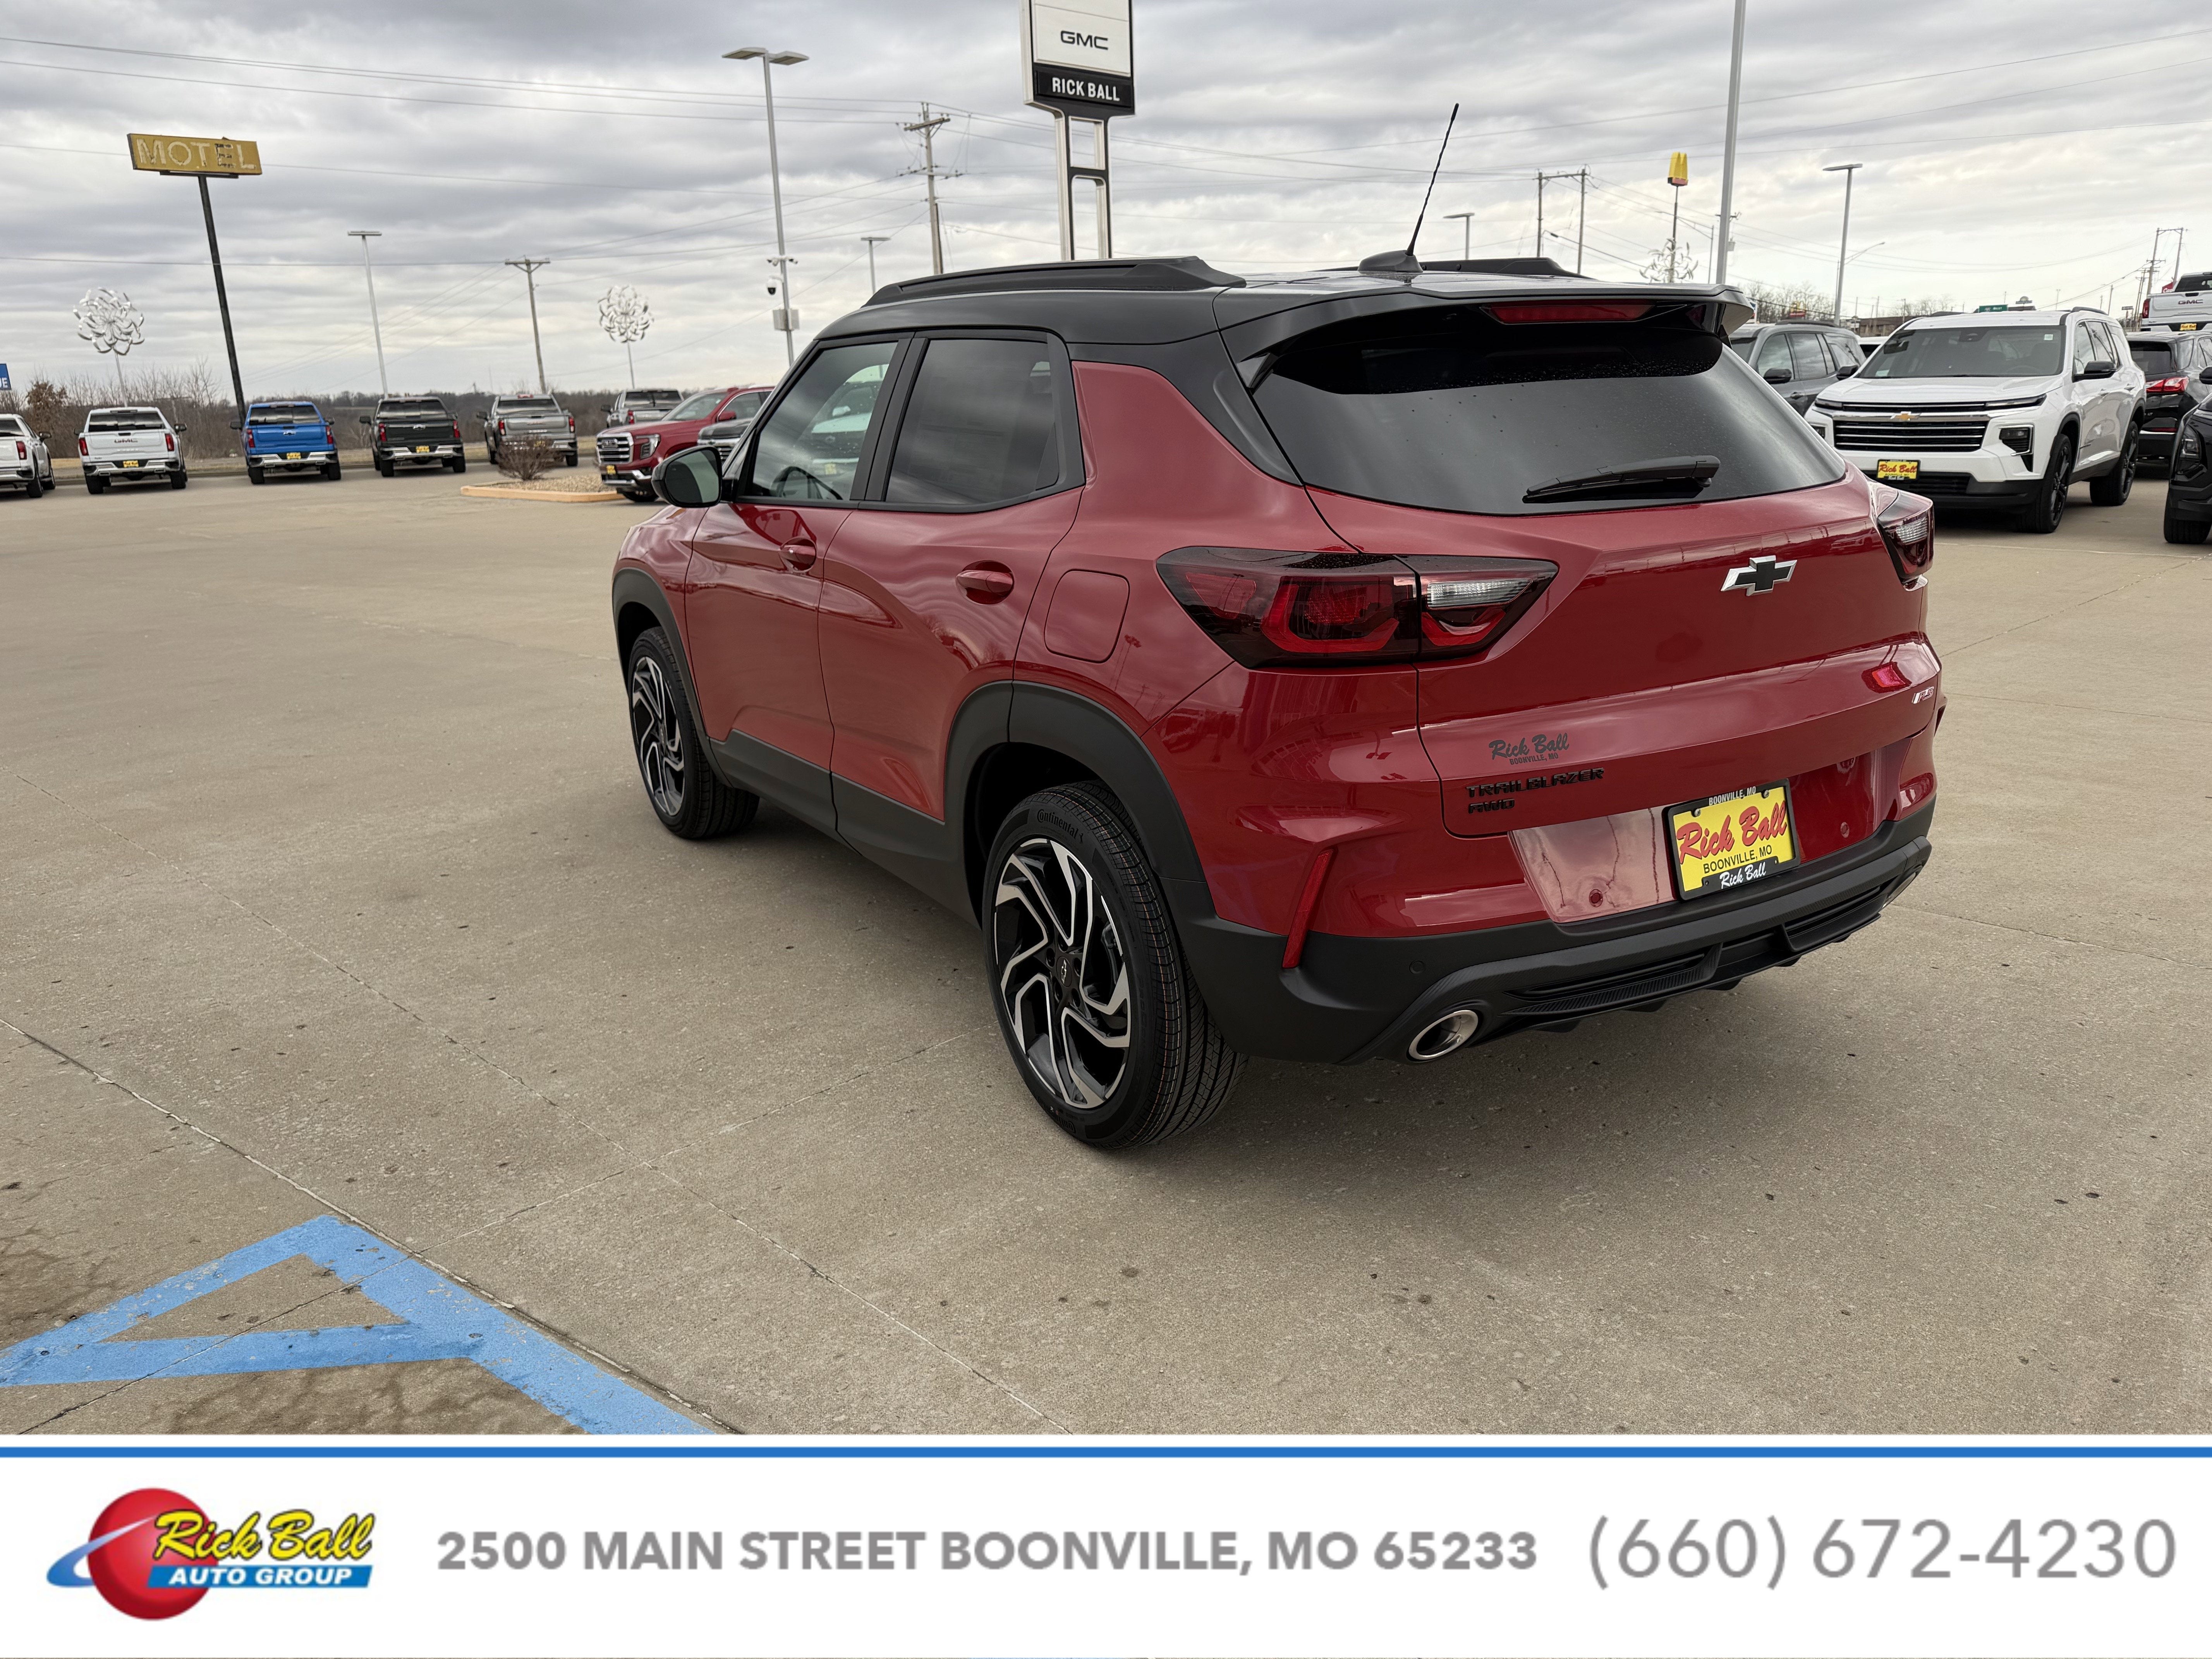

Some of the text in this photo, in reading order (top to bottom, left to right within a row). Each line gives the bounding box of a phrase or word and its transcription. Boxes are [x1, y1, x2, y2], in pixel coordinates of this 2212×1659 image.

[1061, 31, 1108, 50] GMC
[1052, 77, 1120, 101] RICK BALL
[136, 138, 256, 170] MOTEL
[1879, 464, 1917, 473] Rick Ball
[1489, 733, 1570, 760] Rick Ball
[1510, 752, 1559, 765] BOONVILLE, MO
[1465, 767, 1604, 798] TRAILBLAZER
[1709, 786, 1756, 806] BOONVILLE, MO
[1468, 798, 1515, 814] AWD
[1037, 809, 1078, 840] Continental
[1676, 800, 1787, 864] Rick Ball
[1703, 845, 1772, 874] BOONVILLE, MO
[1719, 862, 1766, 889] Rick Ball
